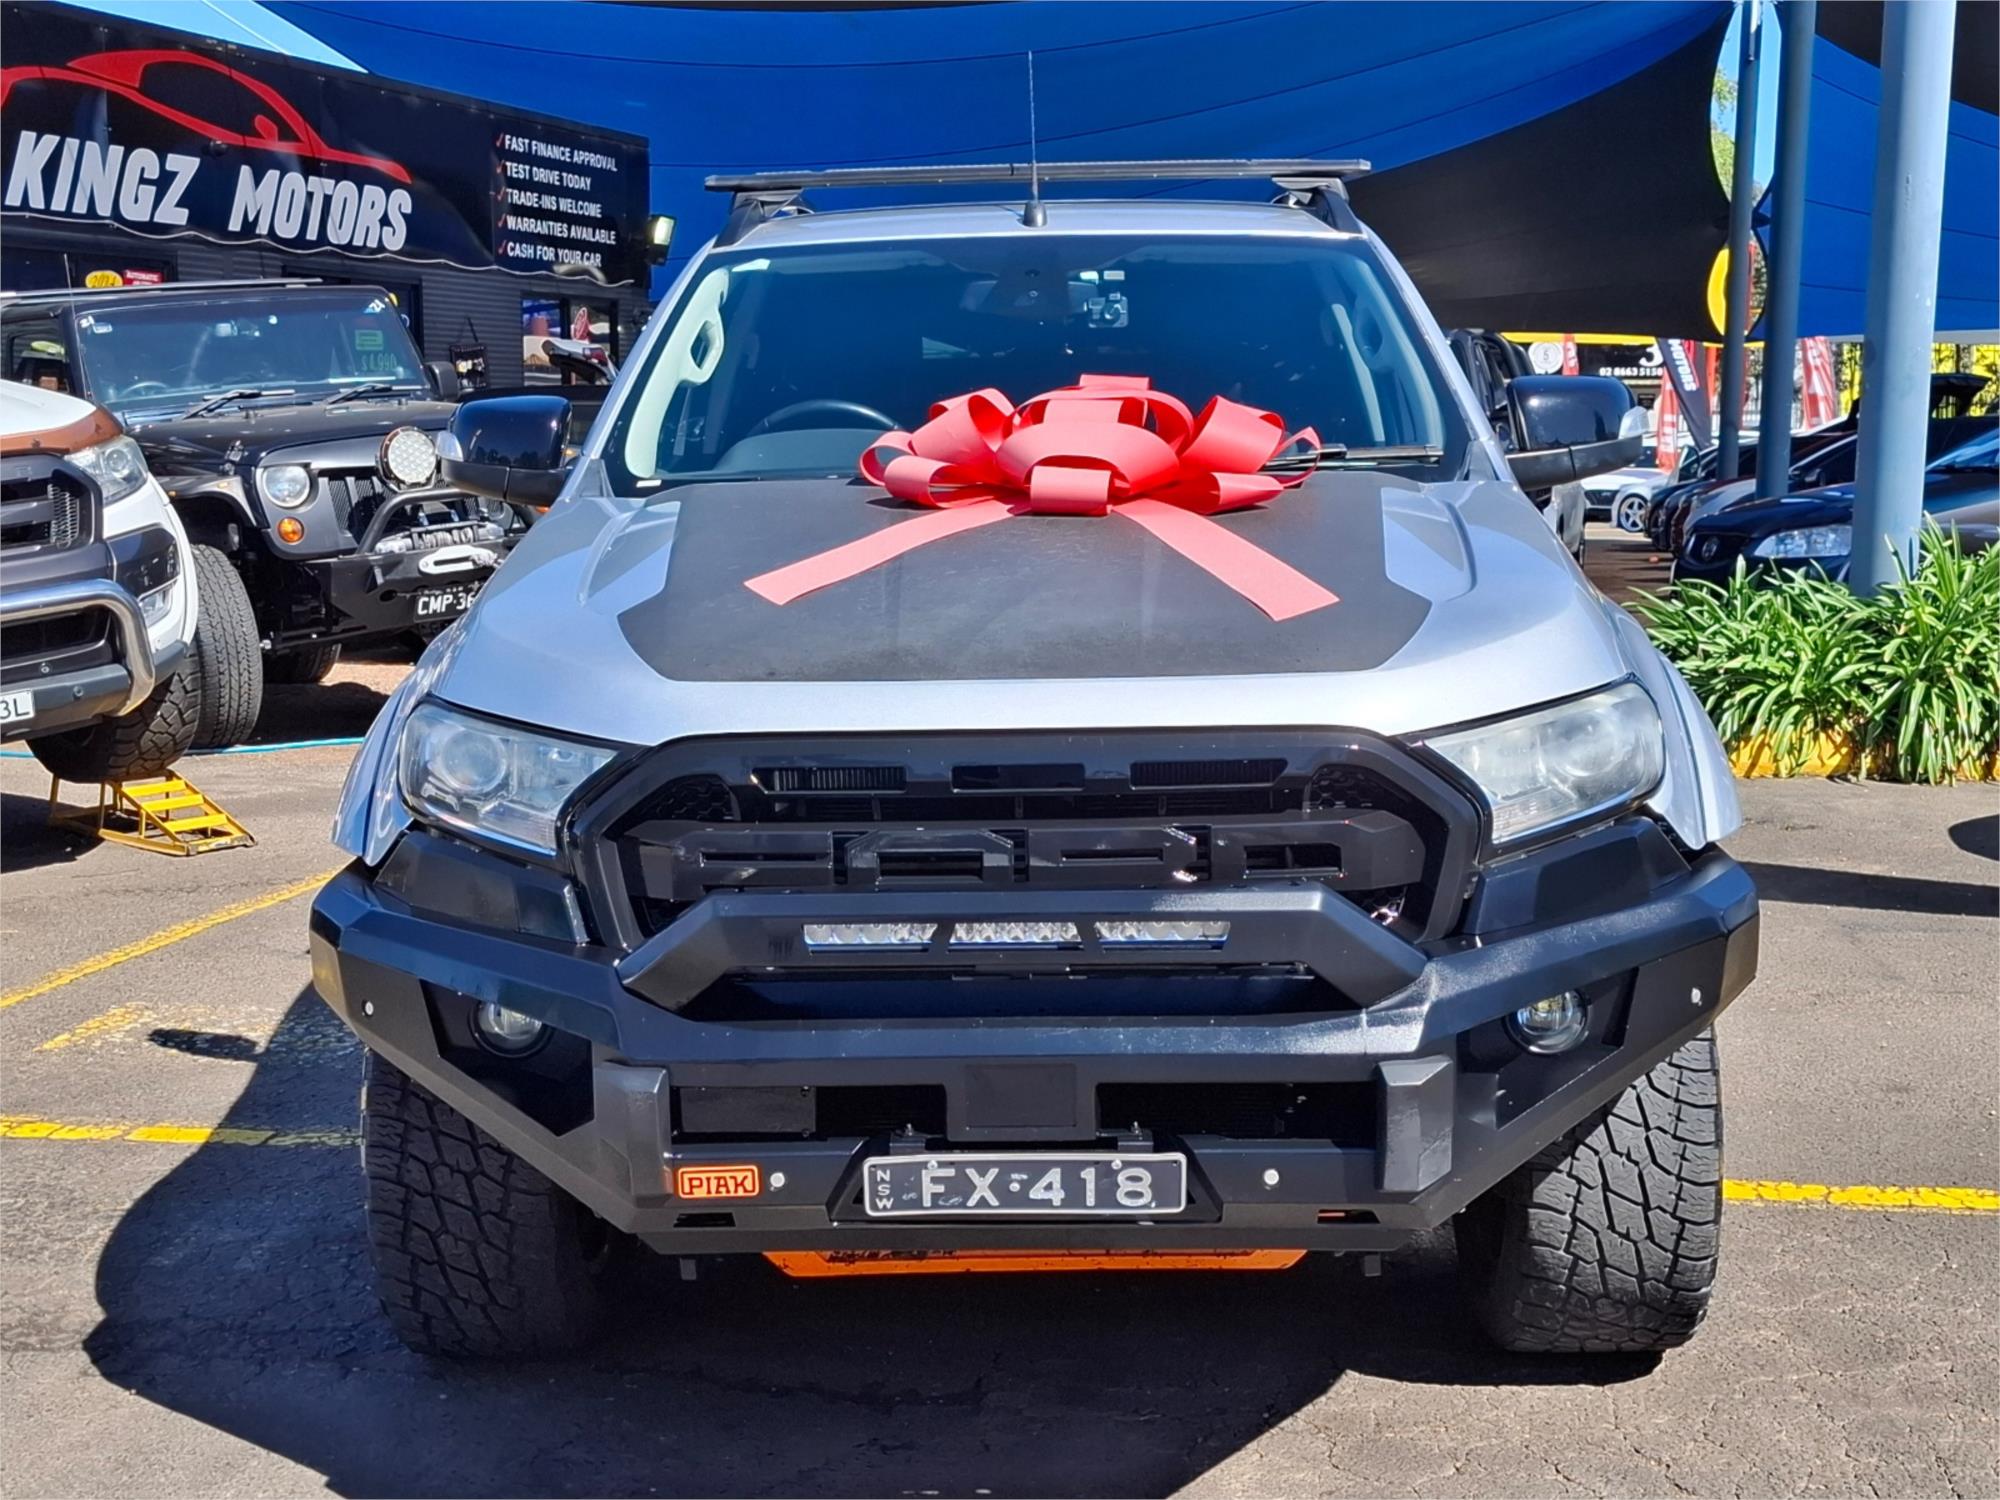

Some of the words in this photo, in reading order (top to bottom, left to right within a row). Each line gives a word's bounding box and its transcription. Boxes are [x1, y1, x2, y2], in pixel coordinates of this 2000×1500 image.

[505, 134, 530, 153] FAST
[531, 140, 572, 162] FINANCE
[573, 150, 618, 172] APPROVAL
[5, 130, 201, 226] KINGZ
[227, 165, 412, 251] MOTORS
[505, 162, 531, 180] TEST
[532, 166, 561, 186] DRIVE
[561, 172, 591, 191] TODAY
[506, 188, 557, 211] TRADE-INS
[558, 197, 602, 218] WELCOME
[506, 215, 569, 238] WARRANTIES
[570, 224, 617, 245] AVAILABLE
[507, 241, 534, 258] CASH
[536, 246, 556, 262] FOR
[557, 248, 582, 264] YOUR
[583, 252, 602, 267] CAR
[1599, 366, 1612, 377] 02
[687, 1174, 751, 1196] PIAK
